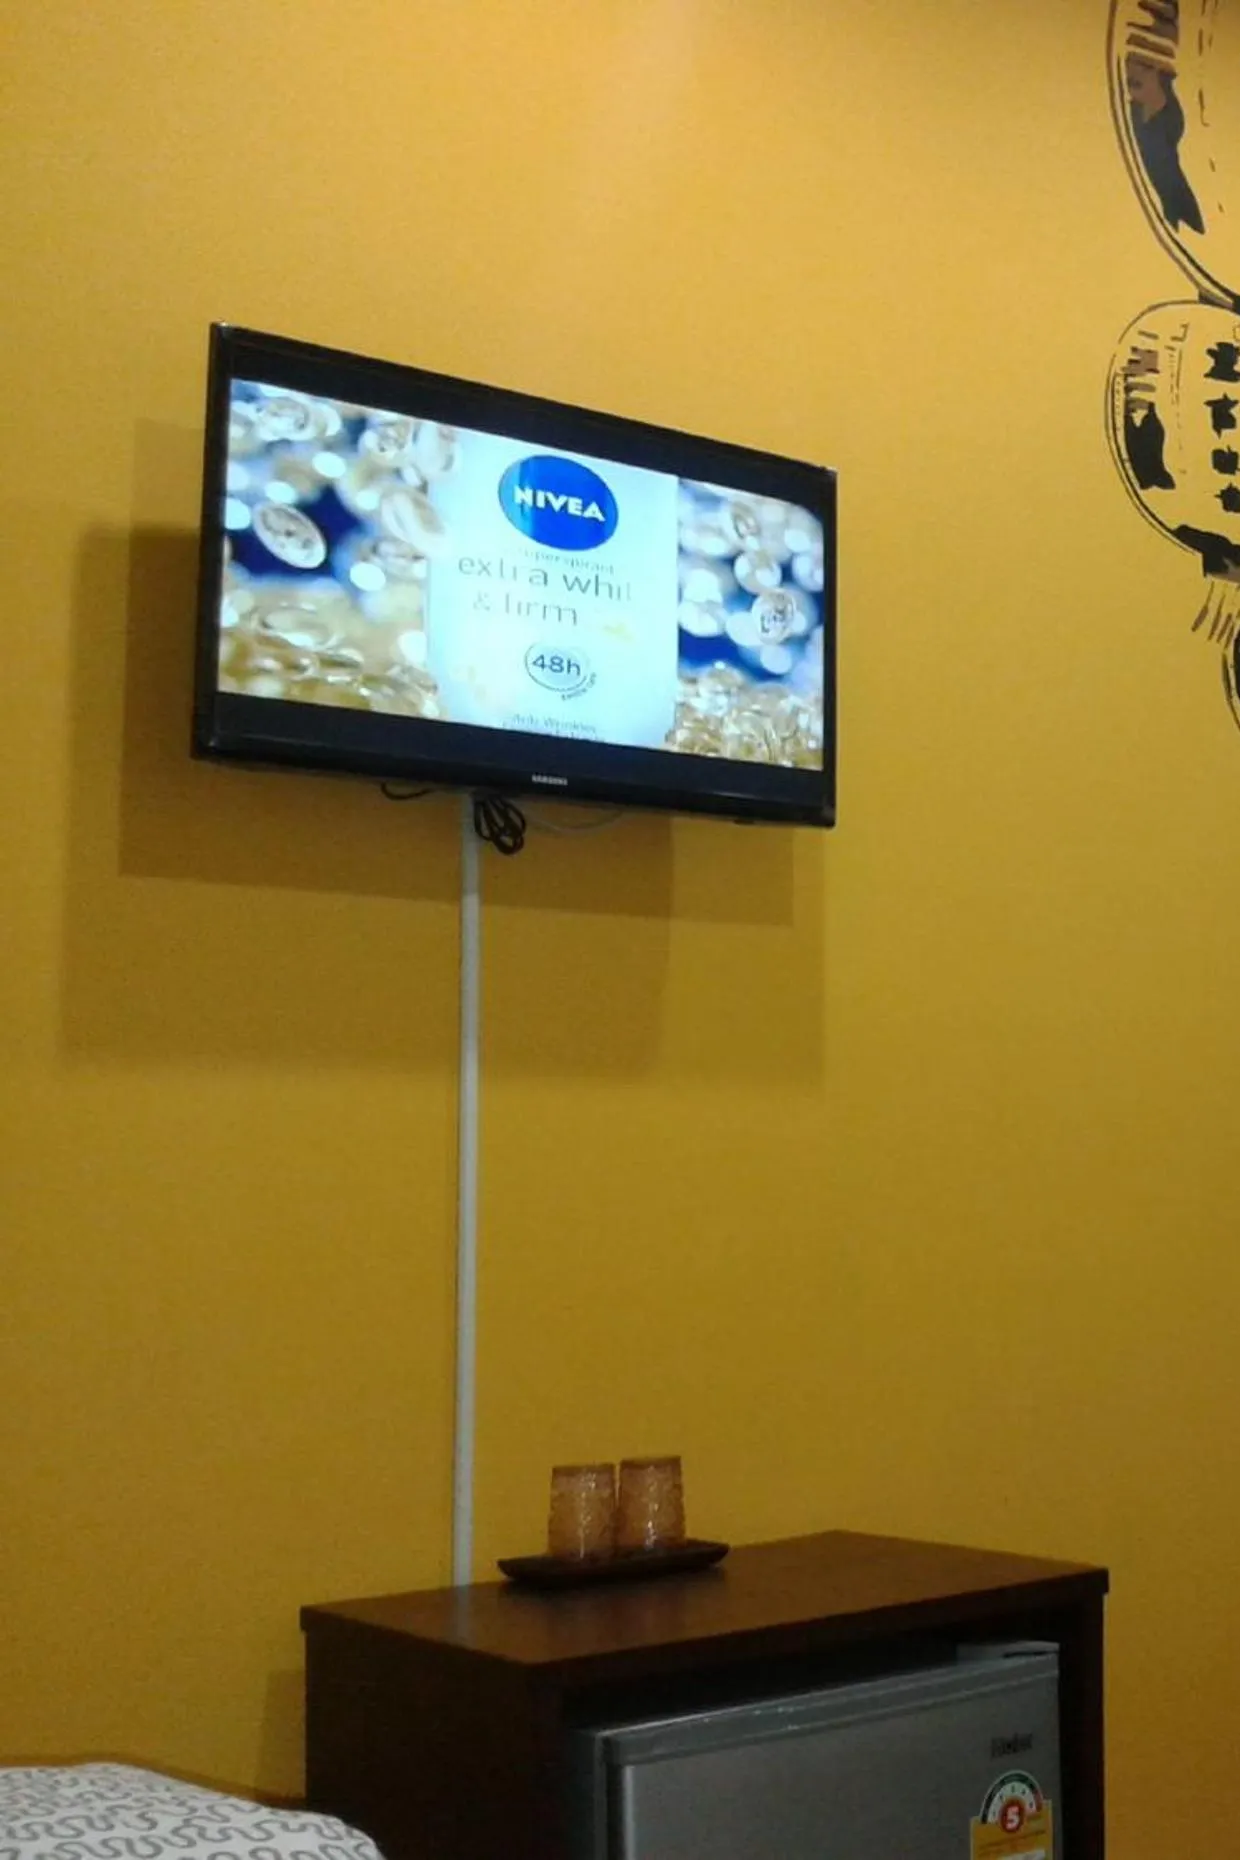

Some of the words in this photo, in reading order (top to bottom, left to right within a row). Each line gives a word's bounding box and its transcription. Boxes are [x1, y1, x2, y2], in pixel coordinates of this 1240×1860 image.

[514, 485, 605, 522] NIVEA
[458, 555, 549, 588] extra
[531, 653, 582, 678] 48h
[1005, 1805, 1020, 1830] 5
